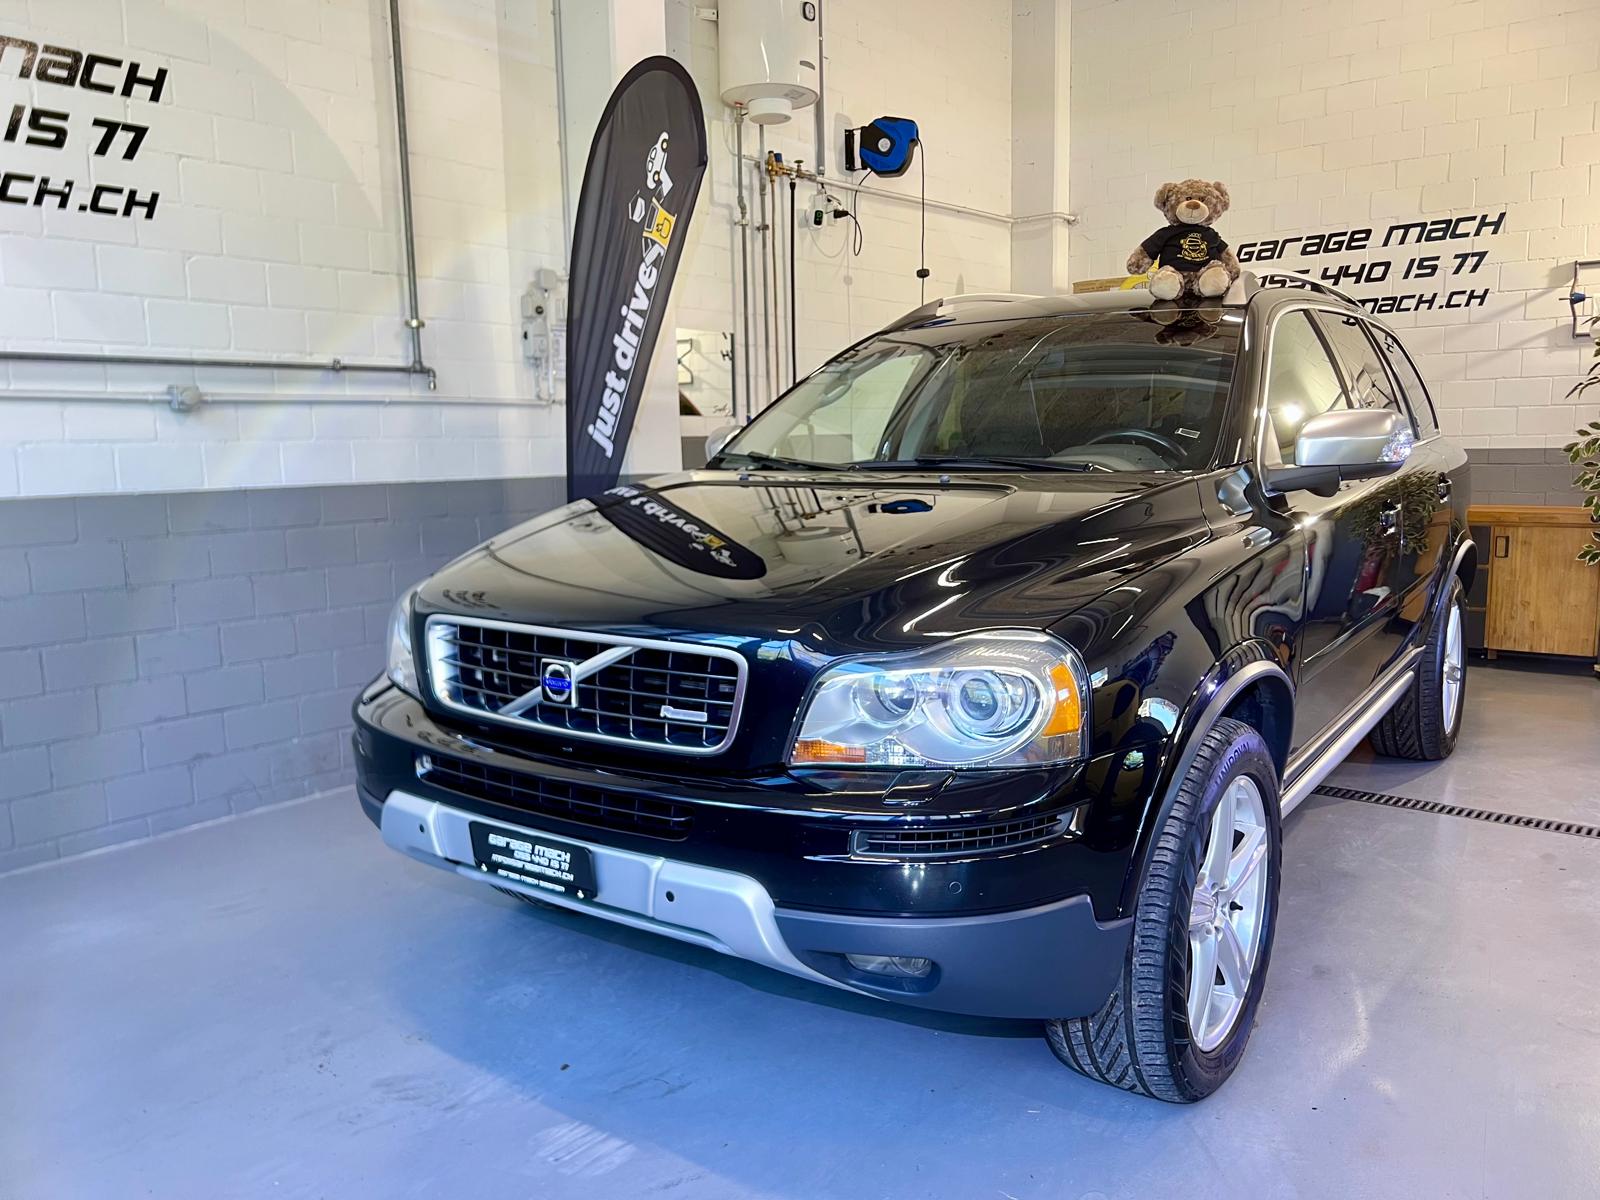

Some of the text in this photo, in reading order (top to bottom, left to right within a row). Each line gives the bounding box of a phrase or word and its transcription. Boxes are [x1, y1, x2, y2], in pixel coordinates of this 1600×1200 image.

[91, 117, 149, 160] 77
[1321, 260, 1391, 286] 440
[1402, 255, 1441, 280] 15
[1452, 250, 1489, 275] 77
[587, 261, 658, 459] just drive
